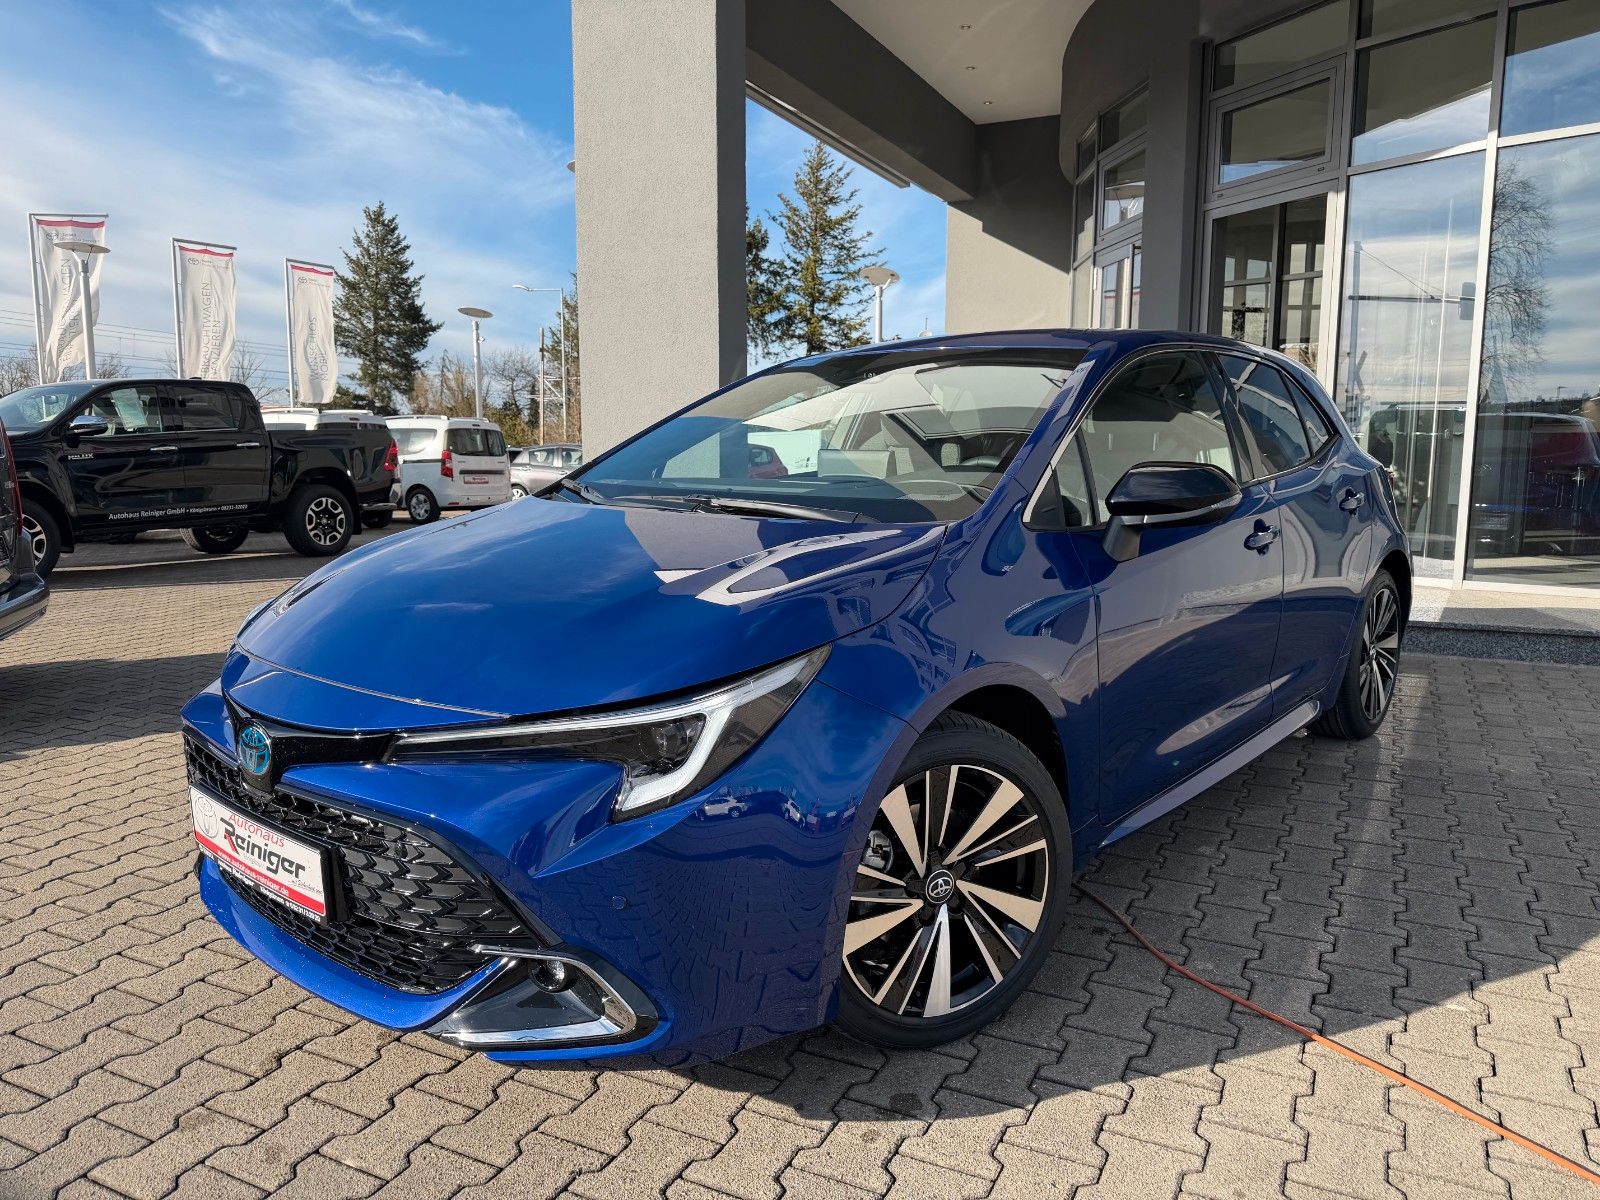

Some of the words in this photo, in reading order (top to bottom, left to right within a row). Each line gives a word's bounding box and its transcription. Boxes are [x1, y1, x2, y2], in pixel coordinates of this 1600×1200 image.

[108, 512, 140, 520] Autohaus
[140, 509, 166, 518] Reiniger
[166, 507, 186, 515] GmbH
[219, 816, 306, 879] Reiniger
[228, 812, 286, 848] Autohaus
